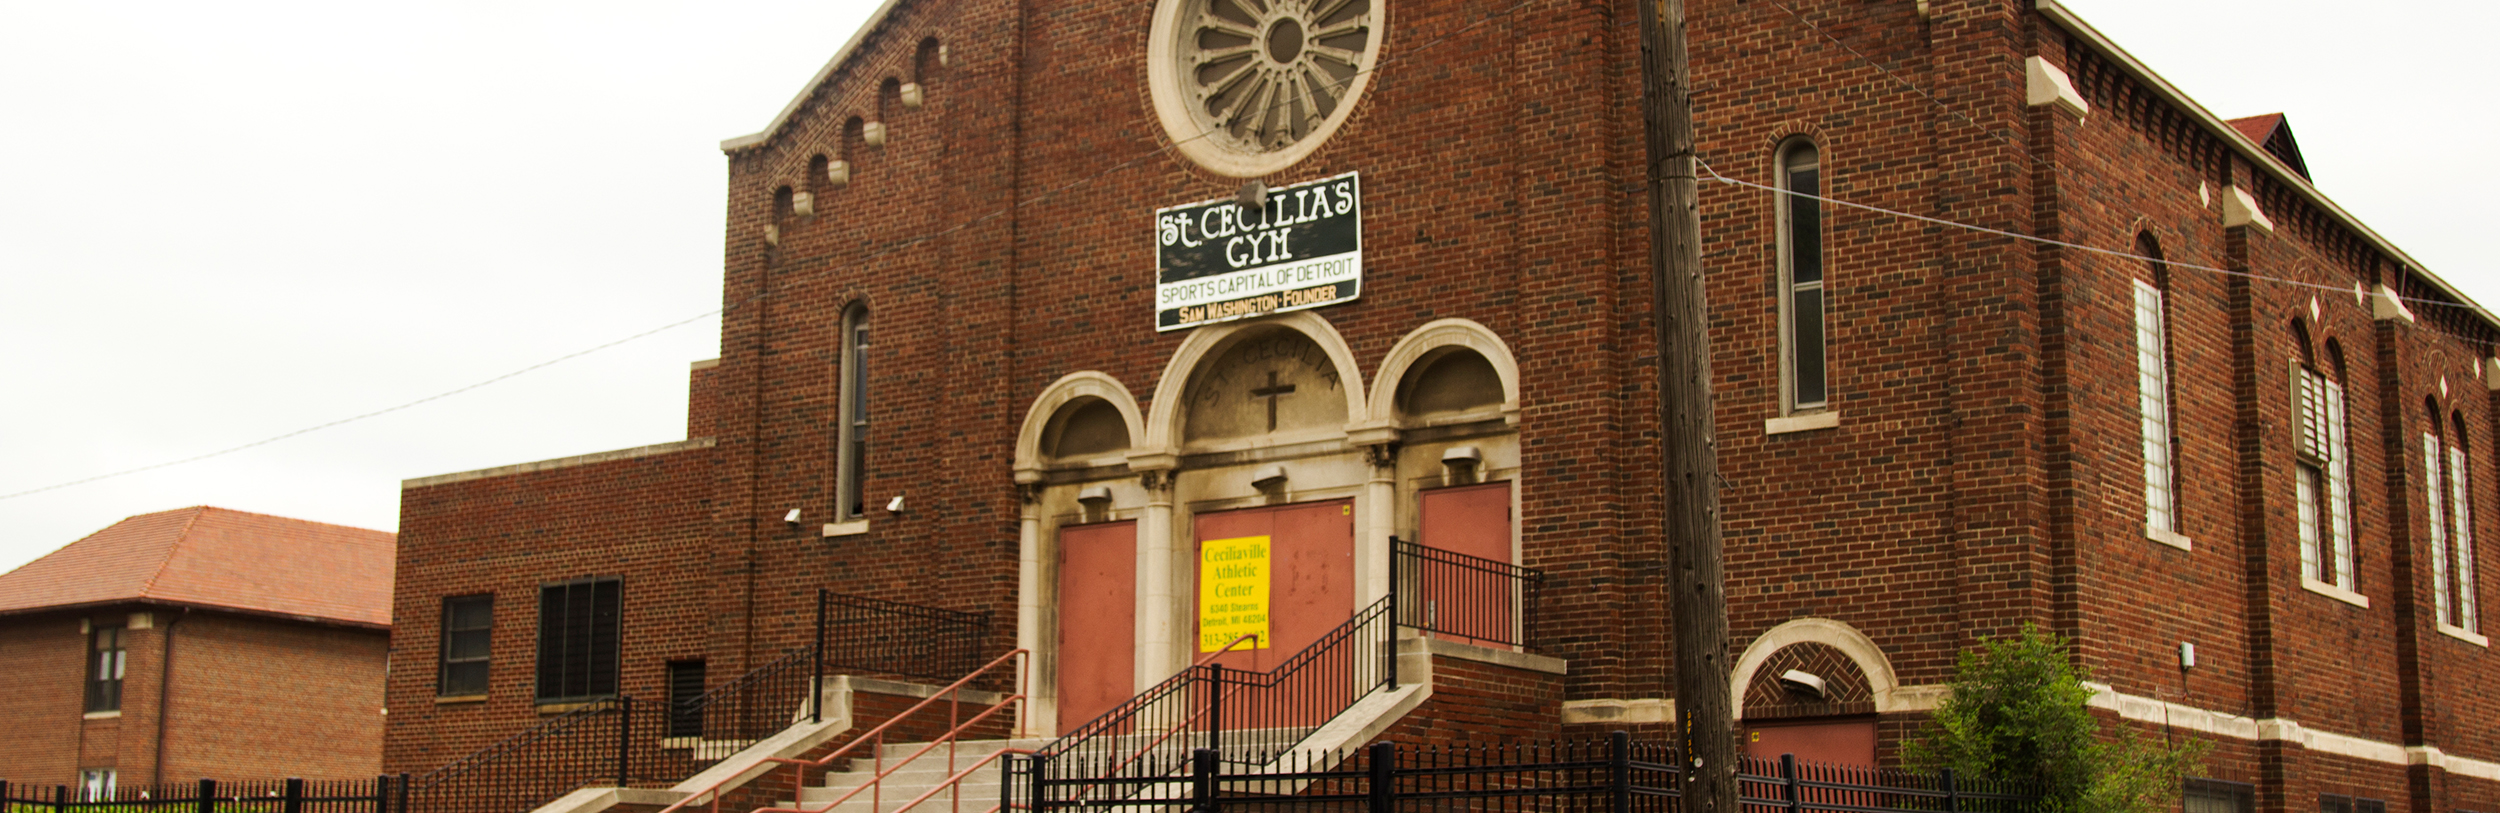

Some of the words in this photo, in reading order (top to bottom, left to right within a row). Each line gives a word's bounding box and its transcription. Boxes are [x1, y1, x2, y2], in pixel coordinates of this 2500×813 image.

[1226, 227, 1293, 268] GYM
[1162, 281, 1215, 304] SPORTS
[1218, 272, 1274, 295] CAPITAL
[1276, 267, 1294, 285] OF
[1297, 257, 1354, 282] DETROIT
[1243, 336, 1339, 391] CECILIA
[1205, 544, 1267, 563] Ceciliaville
[1213, 562, 1257, 580] Athletic
[1215, 583, 1254, 598] Center
[1231, 603, 1258, 612] Stearns
[1231, 616, 1241, 624] MI
[1243, 614, 1266, 624] 48204
